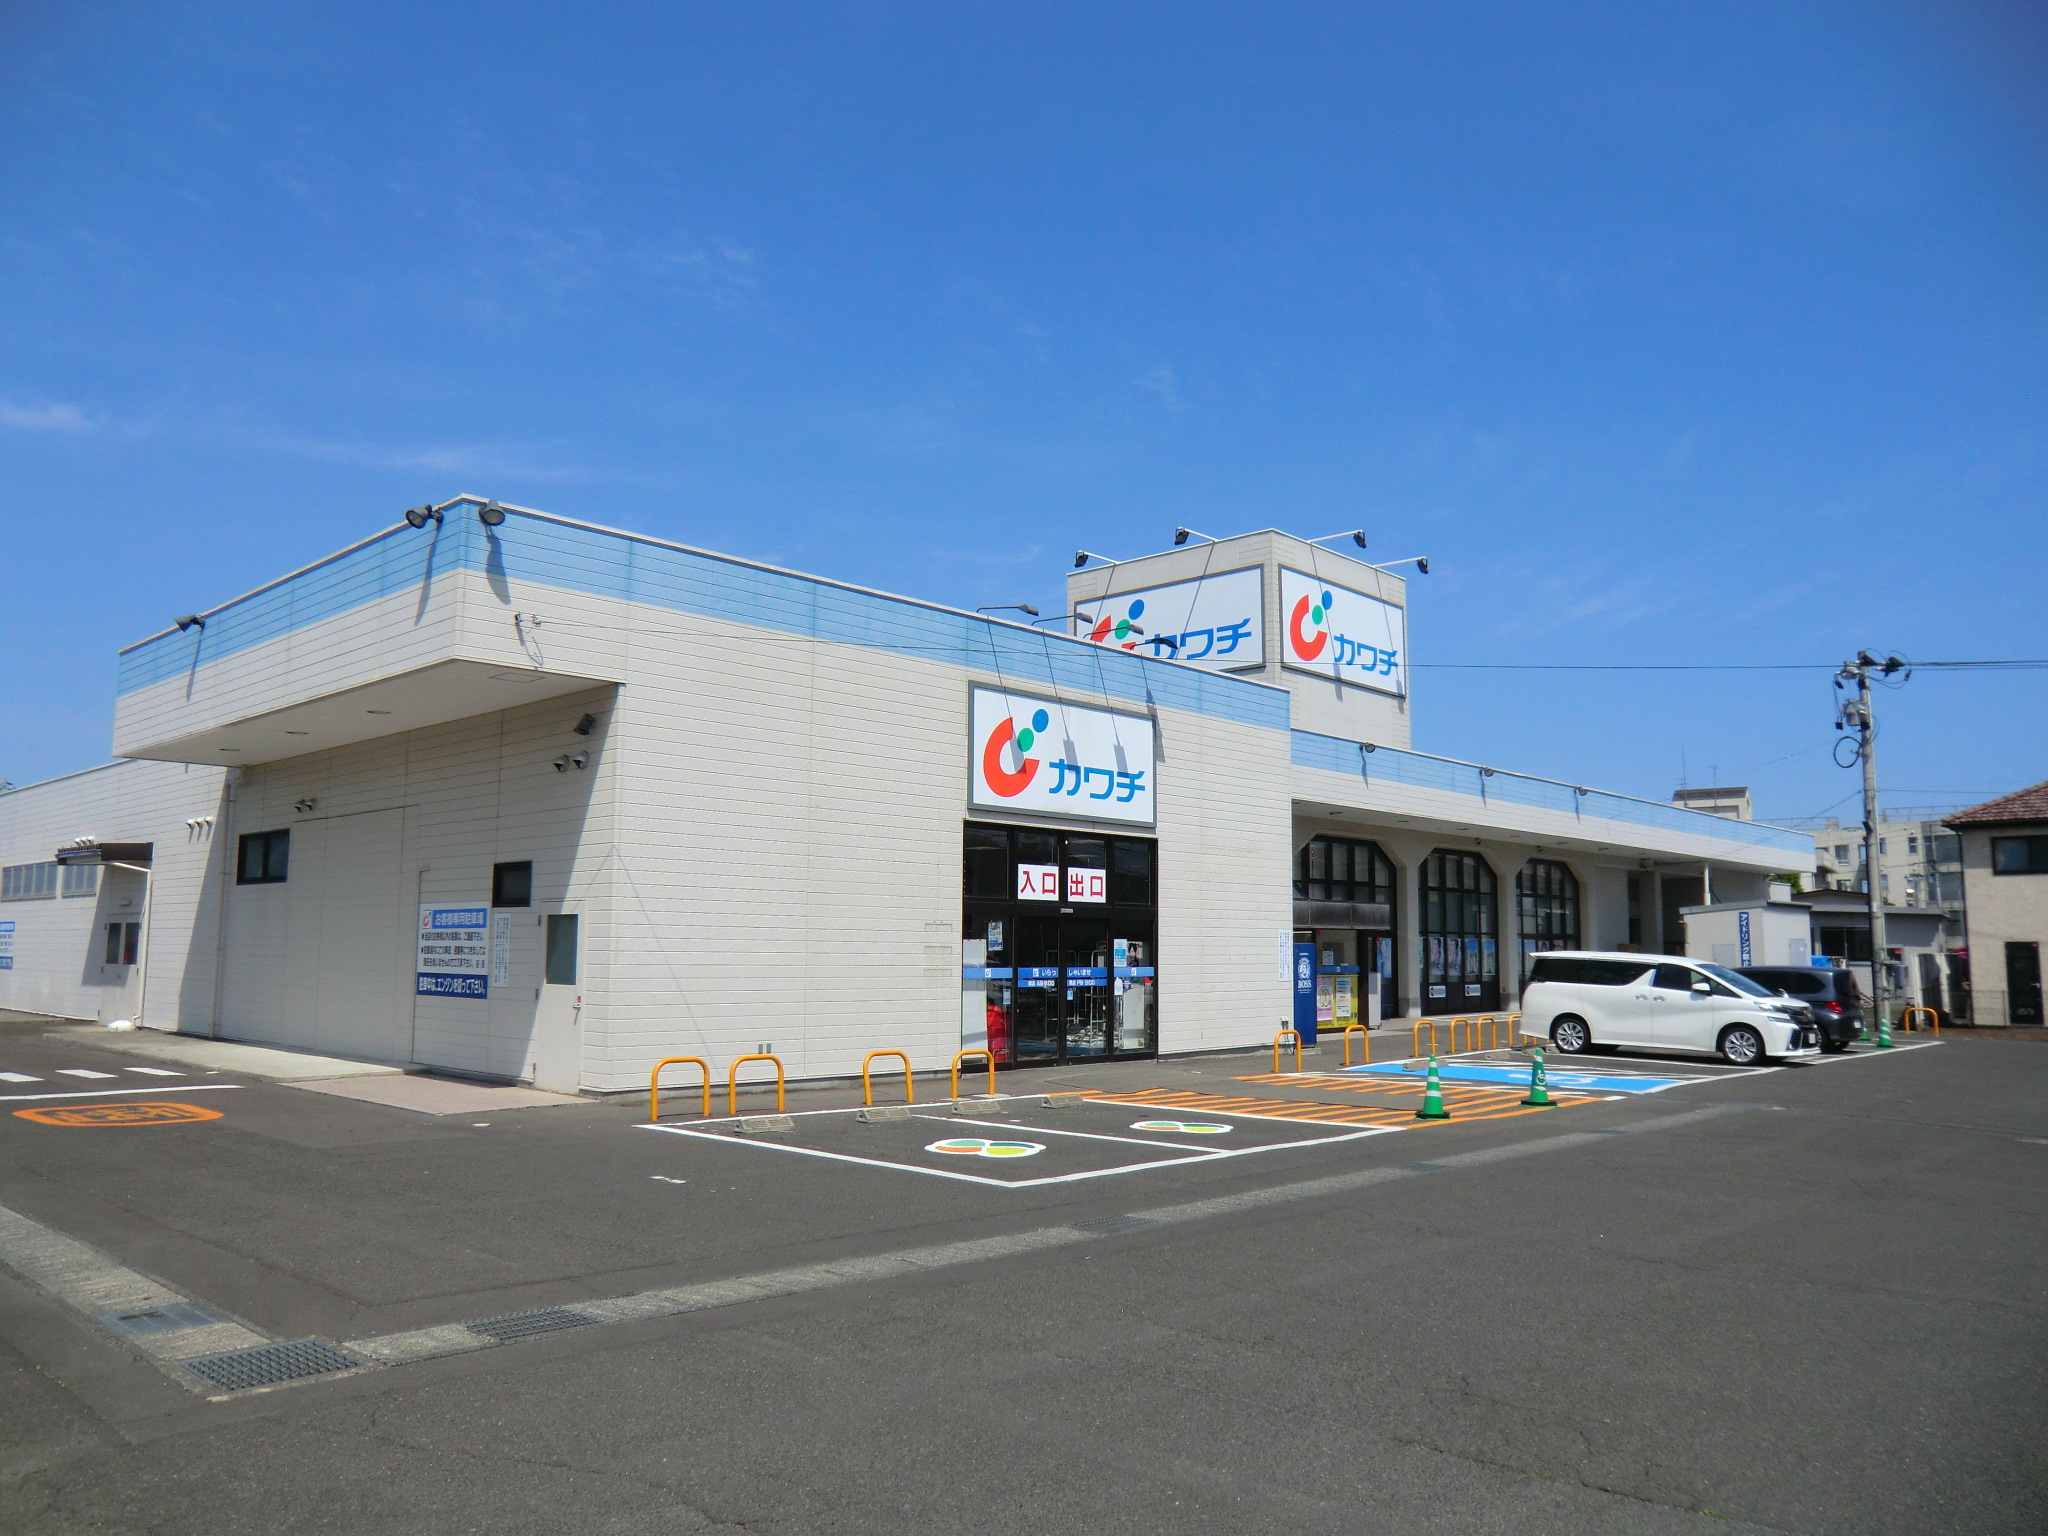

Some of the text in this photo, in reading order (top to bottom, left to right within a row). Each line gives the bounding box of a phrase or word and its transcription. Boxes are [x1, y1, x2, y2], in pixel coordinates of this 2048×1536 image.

[1334, 633, 1398, 676] カワチ
[1049, 758, 1145, 803] カワチ
[1020, 870, 1056, 895] 入口
[1069, 873, 1103, 897] 出口
[435, 912, 484, 925] お客様専用駐車場
[1740, 913, 1750, 967] アイドリング禁止
[1042, 968, 1056, 976] いらっ
[1298, 980, 1311, 988] BOSS
